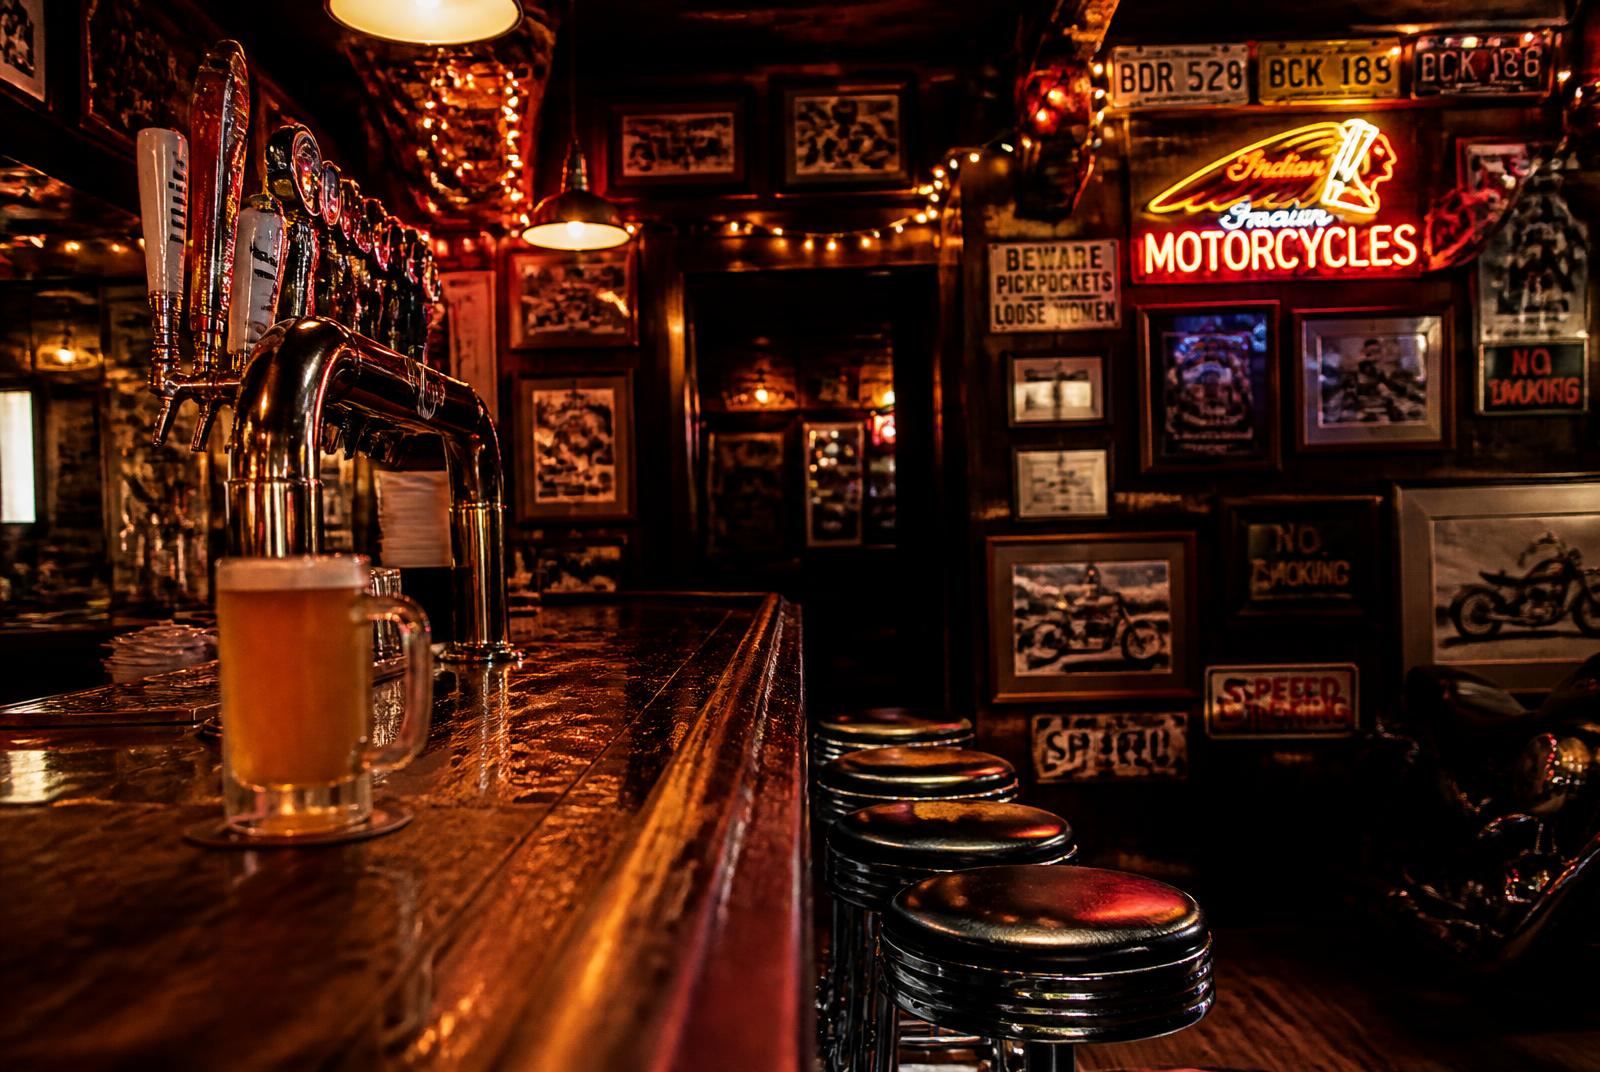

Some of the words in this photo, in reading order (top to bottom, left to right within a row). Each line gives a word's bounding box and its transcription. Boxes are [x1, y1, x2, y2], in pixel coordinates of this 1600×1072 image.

[1121, 61, 1174, 93] BDR
[1187, 60, 1242, 92] 528
[1270, 58, 1324, 88] BCK
[1421, 50, 1479, 83] BCK
[1227, 148, 1326, 182] Indian
[1006, 245, 1102, 272] BEWARE
[1144, 223, 1418, 275] MOTORCYCLES
[997, 271, 1112, 294] PICKPOCKETS
[996, 303, 1046, 325] LOOSE
[1053, 301, 1115, 322] WOMEN
[1510, 346, 1552, 377] NO
